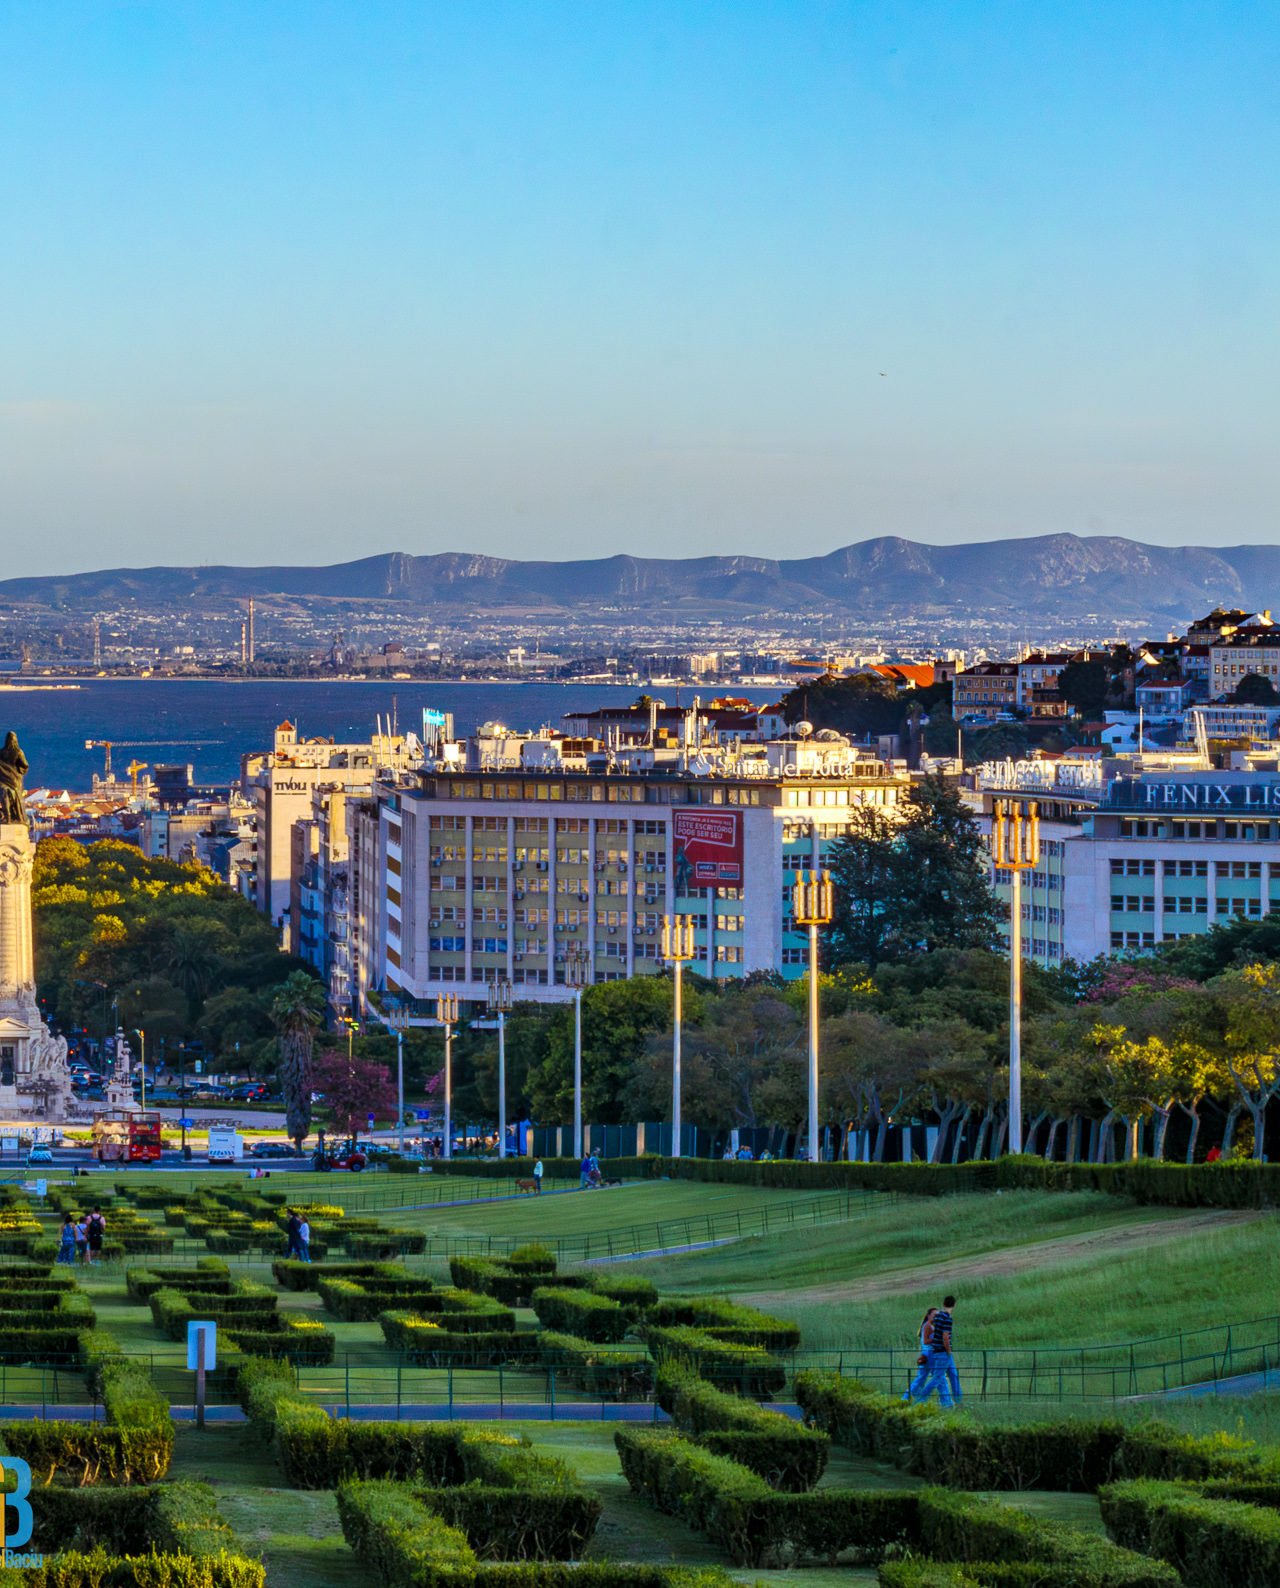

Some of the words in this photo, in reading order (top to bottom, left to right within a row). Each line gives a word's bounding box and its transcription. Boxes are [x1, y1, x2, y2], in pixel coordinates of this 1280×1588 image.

[274, 776, 307, 791] TIVOLI
[1144, 779, 1233, 805] FÉNIX
[695, 823, 732, 833] ESCRITÓRIO
